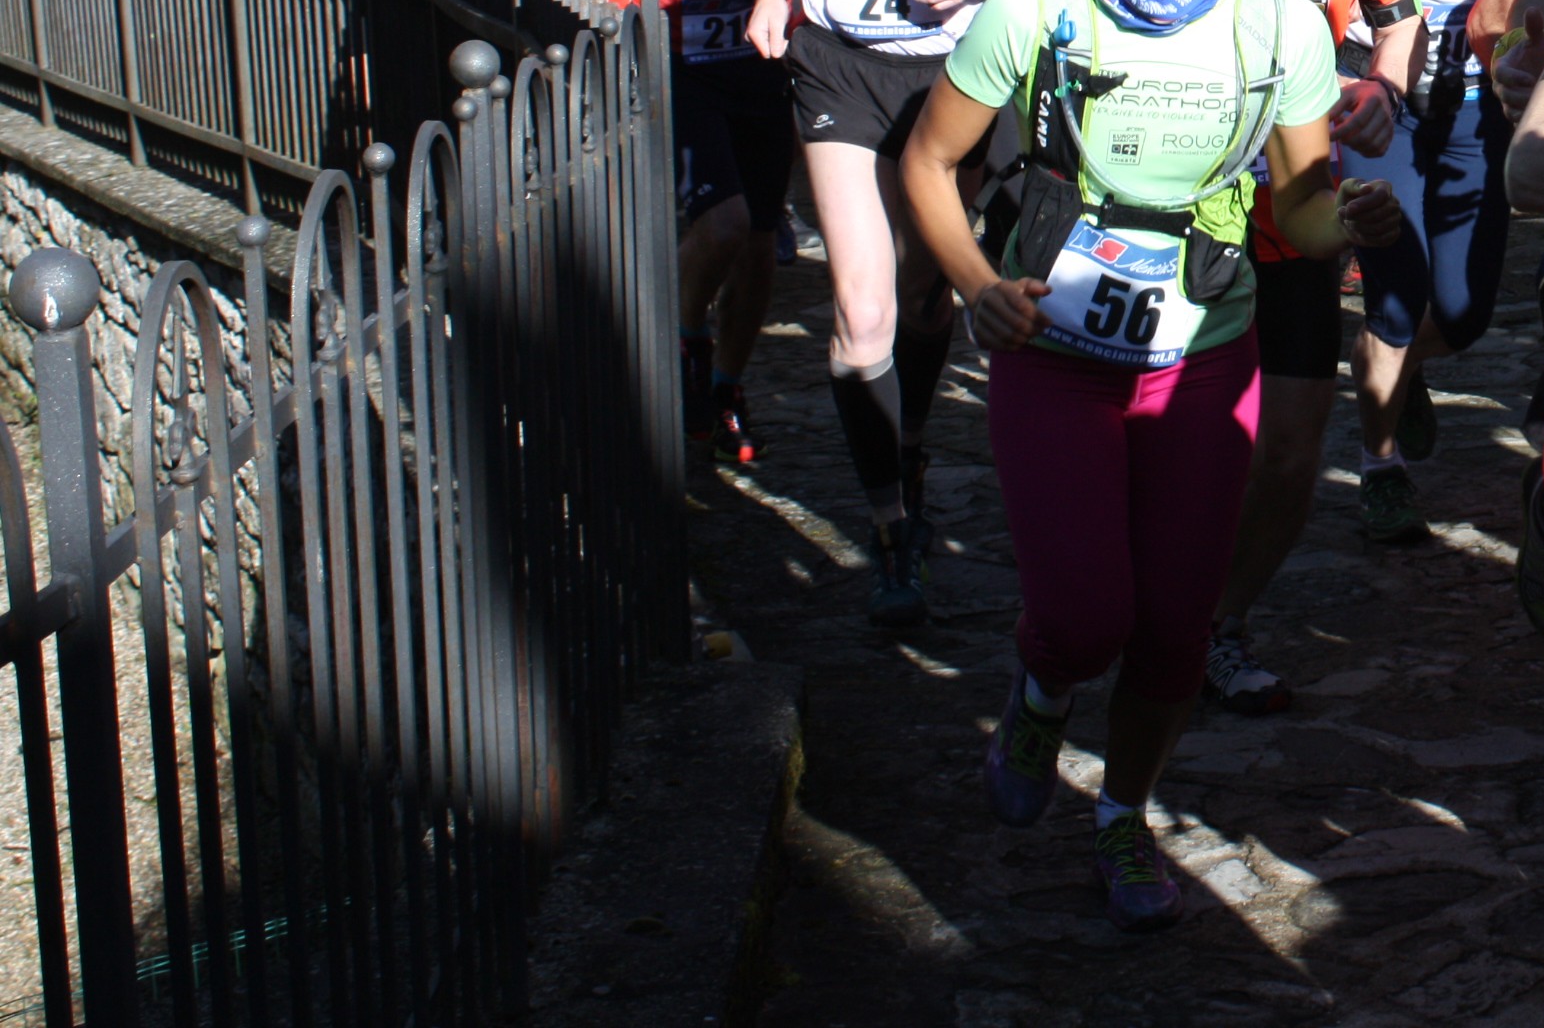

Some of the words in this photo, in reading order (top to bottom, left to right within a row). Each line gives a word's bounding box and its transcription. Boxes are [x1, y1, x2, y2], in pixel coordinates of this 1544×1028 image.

[703, 12, 752, 50] 21
[1120, 79, 1224, 94] UROPE
[1097, 92, 1237, 110] ARATHON
[1036, 90, 1052, 149] CAMP
[1162, 133, 1231, 149] ROUG
[1084, 273, 1166, 346] 56
